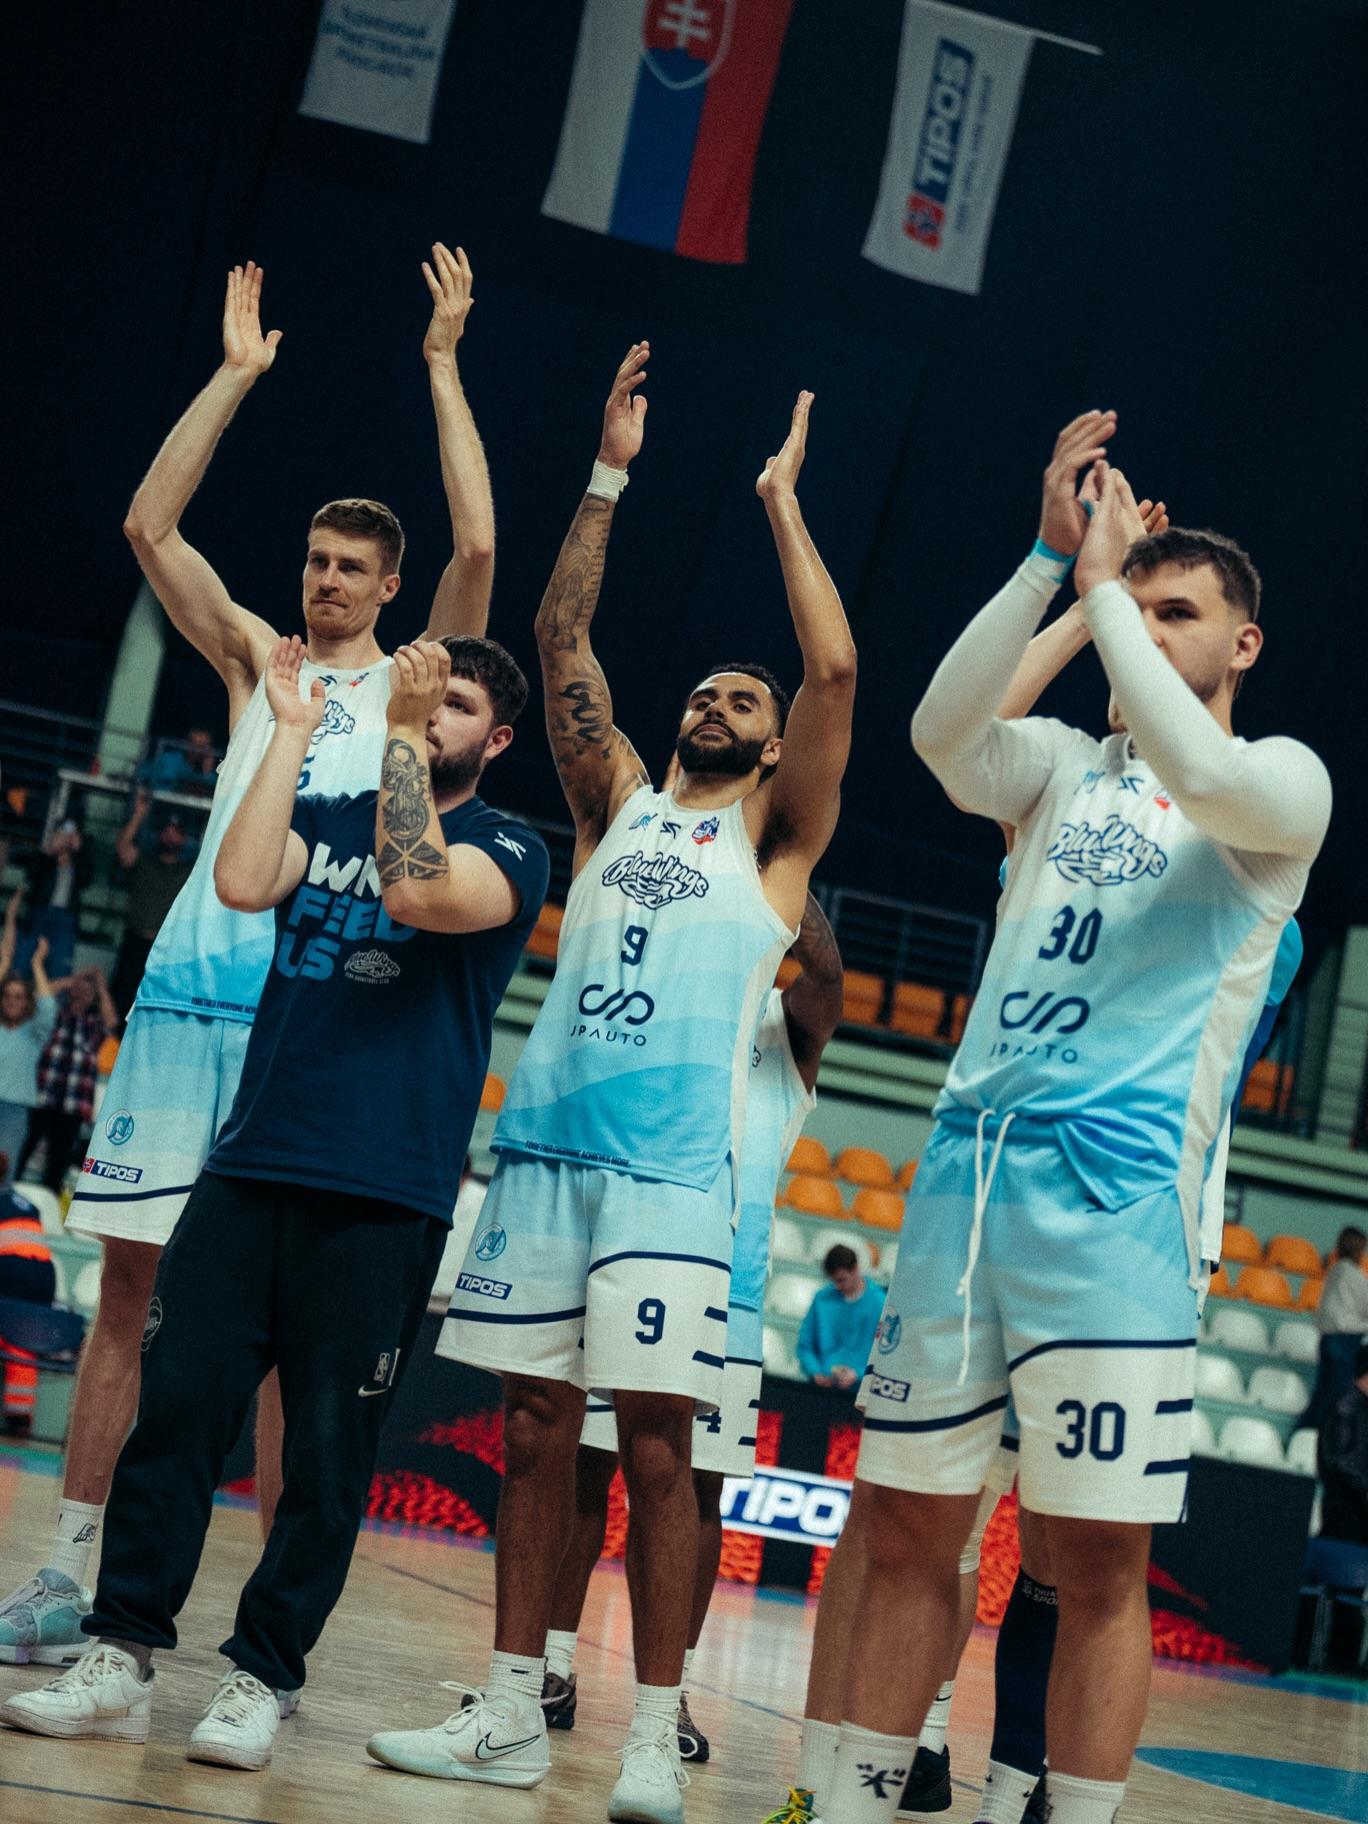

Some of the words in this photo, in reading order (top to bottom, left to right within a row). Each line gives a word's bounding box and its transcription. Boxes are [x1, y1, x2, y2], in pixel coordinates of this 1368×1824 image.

[917, 45, 971, 187] TIPOS
[276, 931, 341, 981] US
[621, 924, 649, 966] 9
[1039, 904, 1103, 965] 30
[96, 1161, 139, 1181] TIPOS
[459, 1275, 508, 1298] TIPOS
[635, 1297, 666, 1345] 9
[872, 1375, 908, 1399] POS
[1055, 1399, 1127, 1462] 30
[720, 1476, 850, 1537] TIPO
